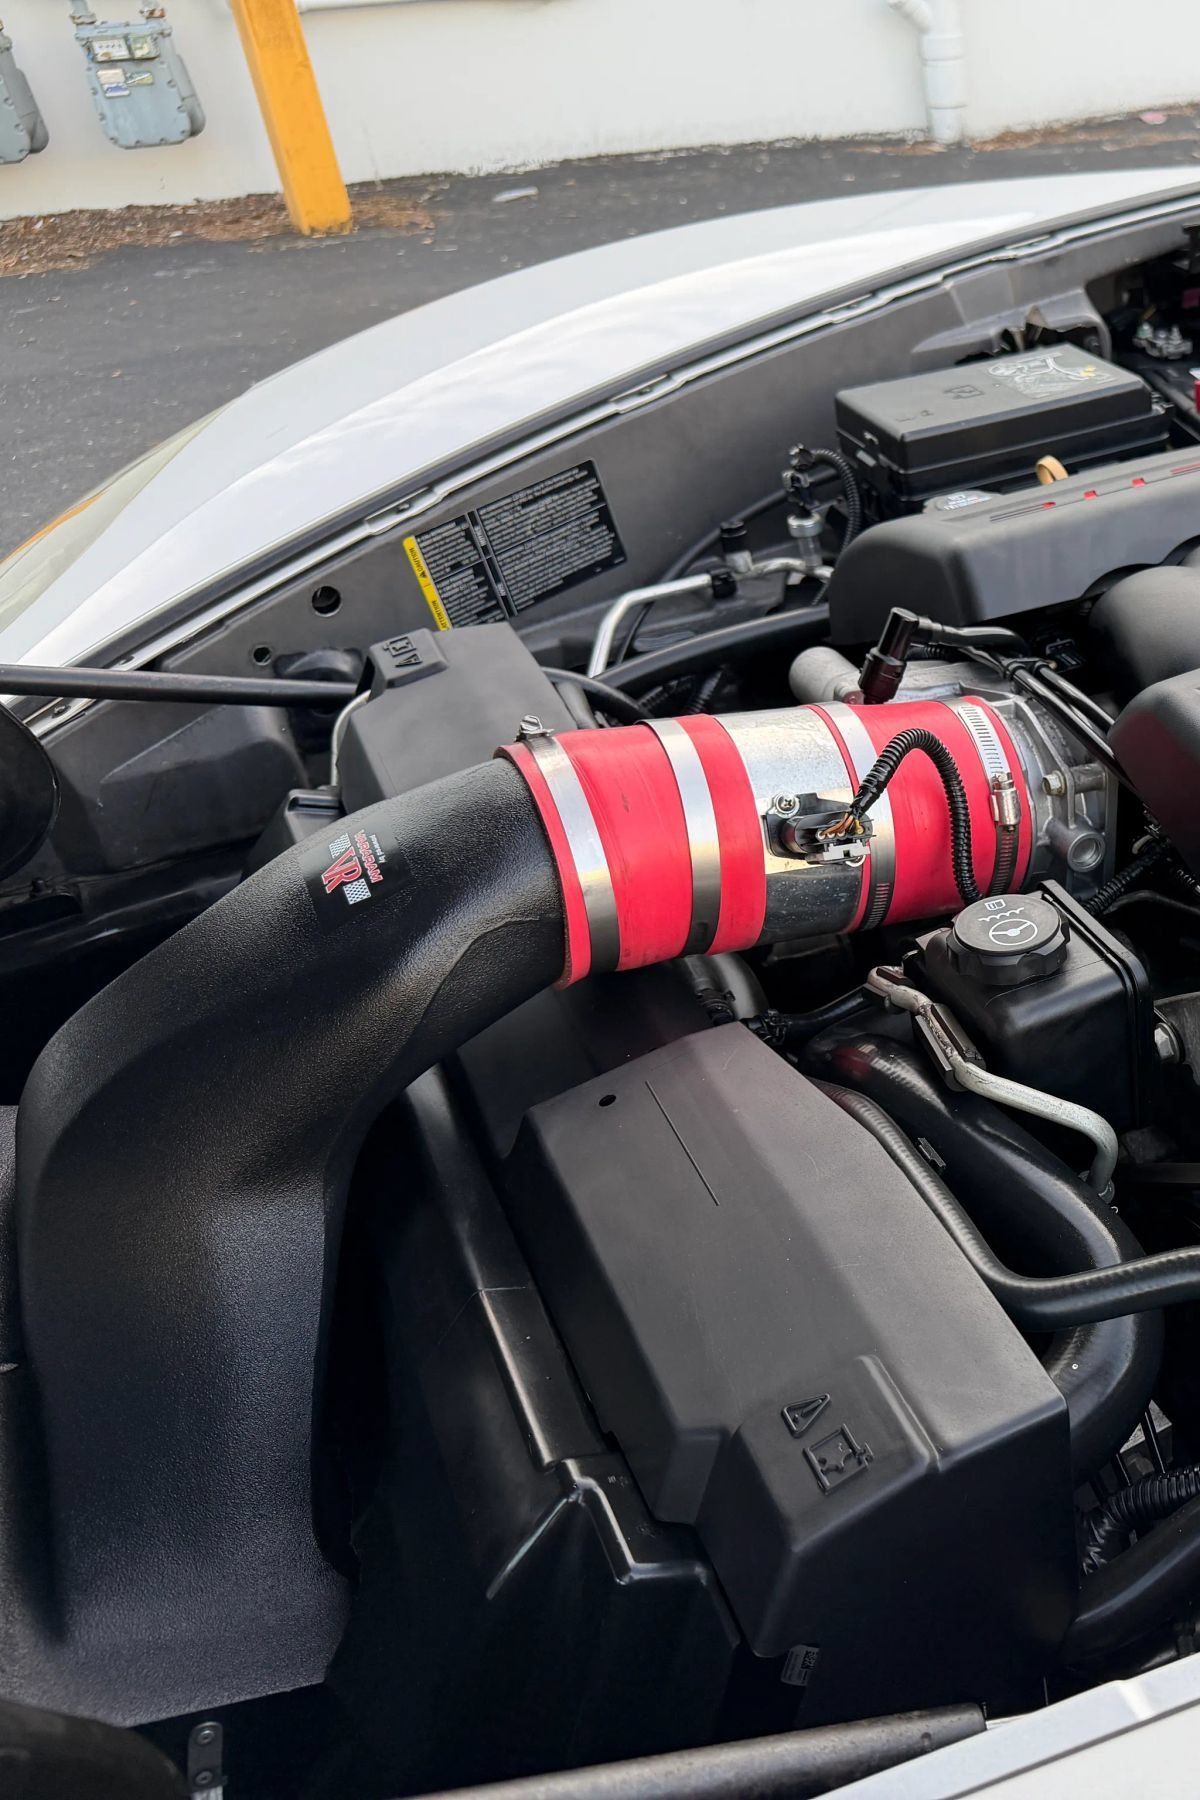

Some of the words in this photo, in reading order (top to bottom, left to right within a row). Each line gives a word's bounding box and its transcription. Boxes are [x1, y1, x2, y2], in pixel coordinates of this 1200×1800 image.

[408, 547, 426, 572] CAUTION
[354, 829, 384, 883] VARARAM
[369, 834, 384, 855] powered
[378, 853, 387, 864] by
[321, 846, 363, 894] VR
